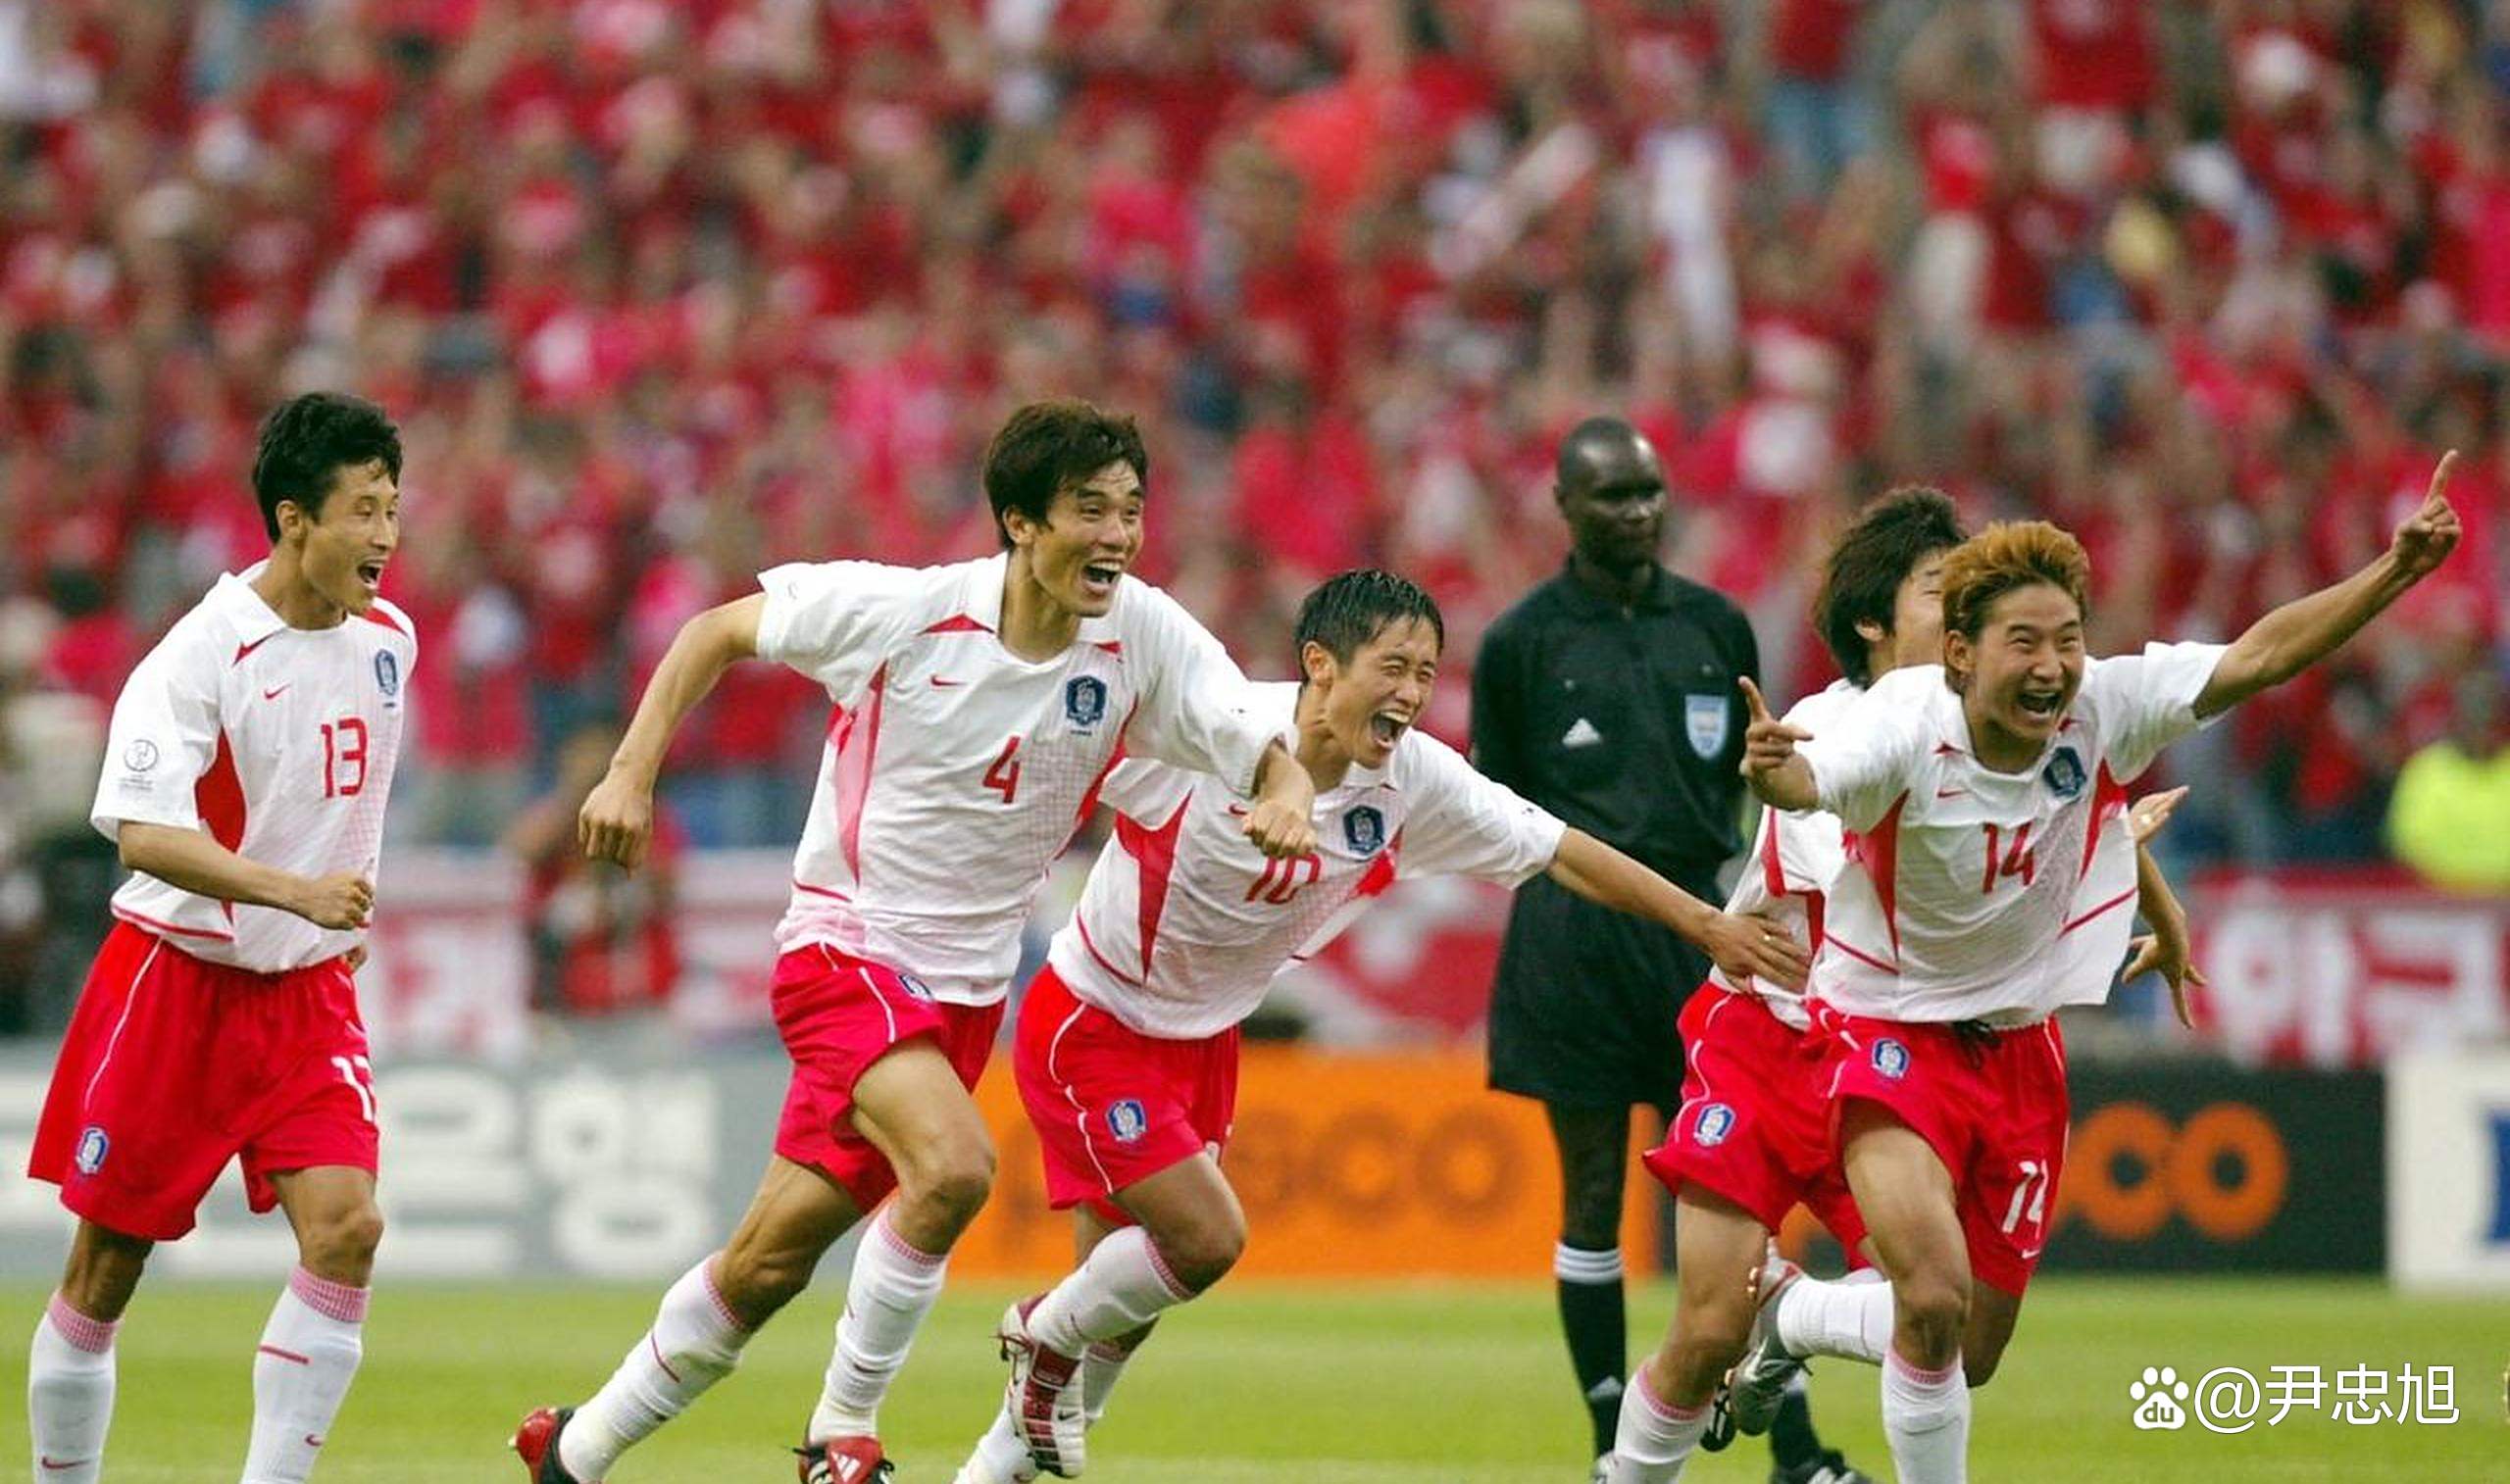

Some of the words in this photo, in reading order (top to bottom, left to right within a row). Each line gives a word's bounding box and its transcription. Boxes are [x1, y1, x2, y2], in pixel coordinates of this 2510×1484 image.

[321, 718, 367, 798] 13
[982, 736, 1021, 804] 4
[1244, 853, 1321, 904] 10
[1983, 820, 2034, 896] 14
